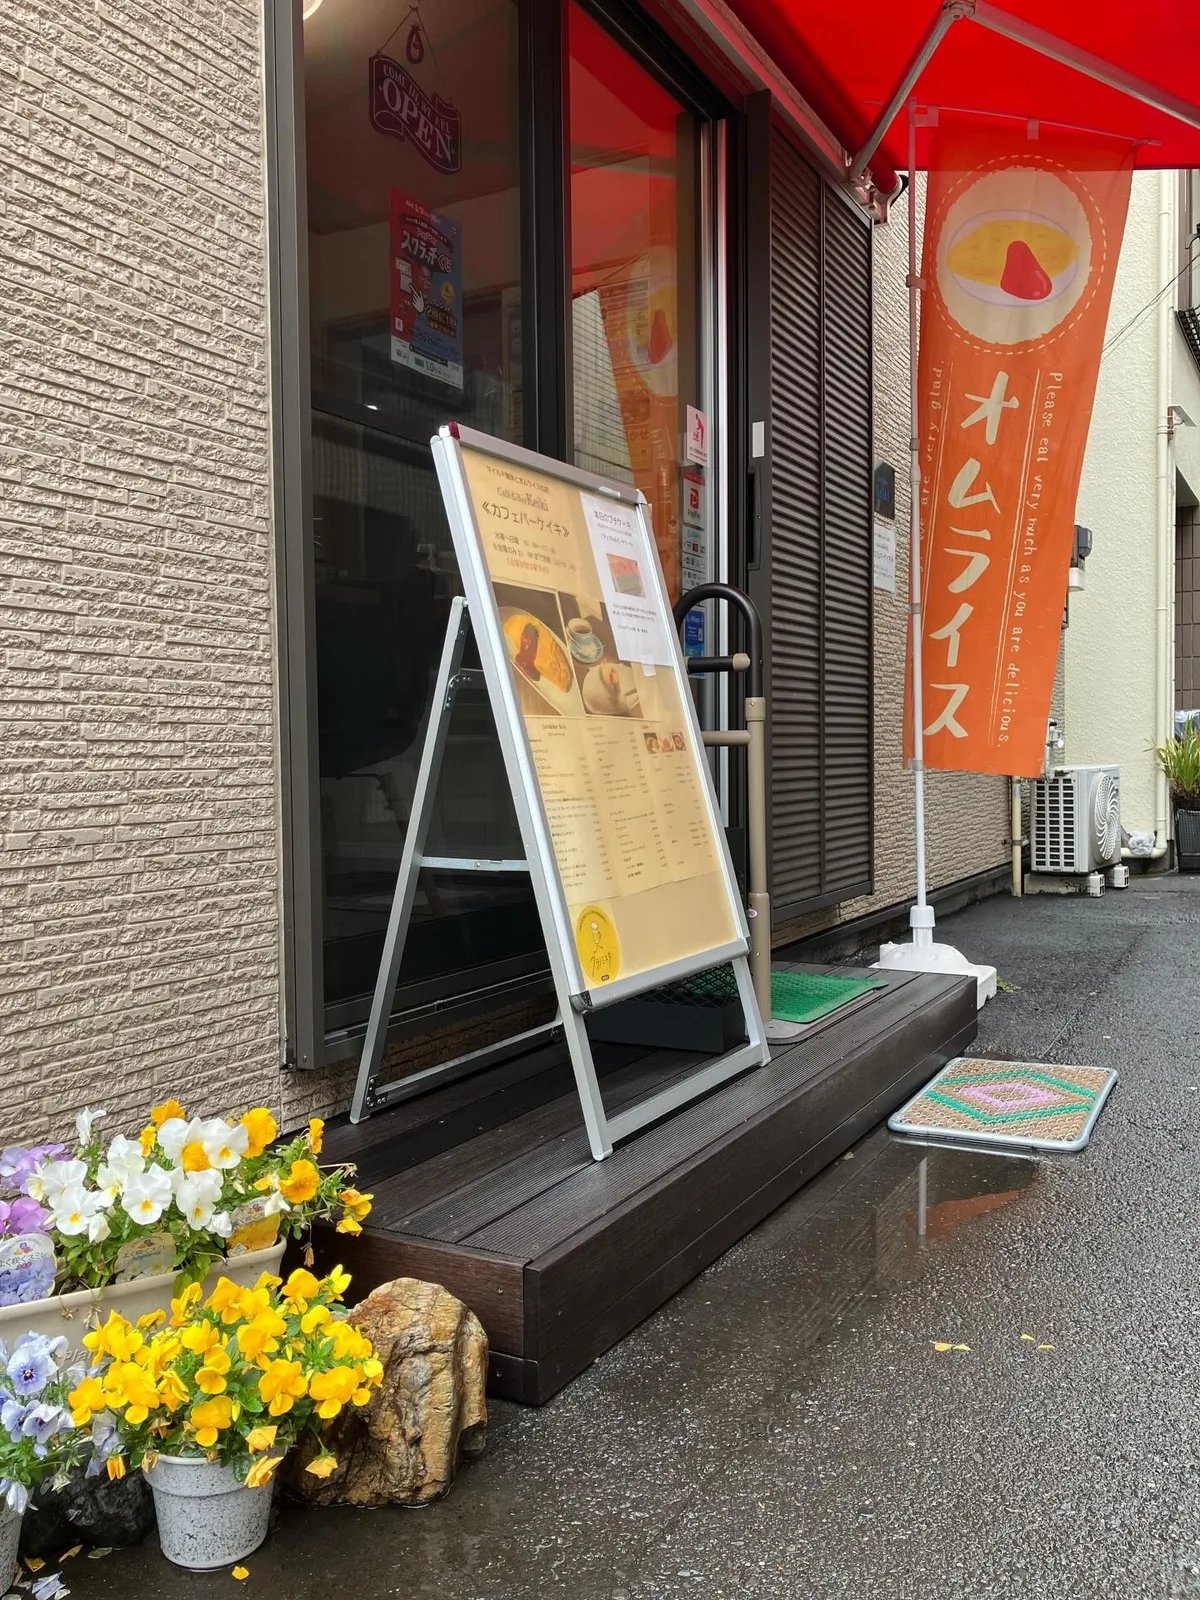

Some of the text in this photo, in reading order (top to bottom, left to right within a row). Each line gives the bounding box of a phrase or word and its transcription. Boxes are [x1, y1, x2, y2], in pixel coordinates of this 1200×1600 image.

[383, 64, 405, 88] COME
[382, 77, 453, 163] OPEN
[401, 229, 453, 274] スクラッチくじ
[921, 475, 930, 506] are
[926, 422, 941, 463] very
[922, 369, 1020, 739] オムライス
[996, 370, 1063, 750] Please eat very much as you are delicious.
